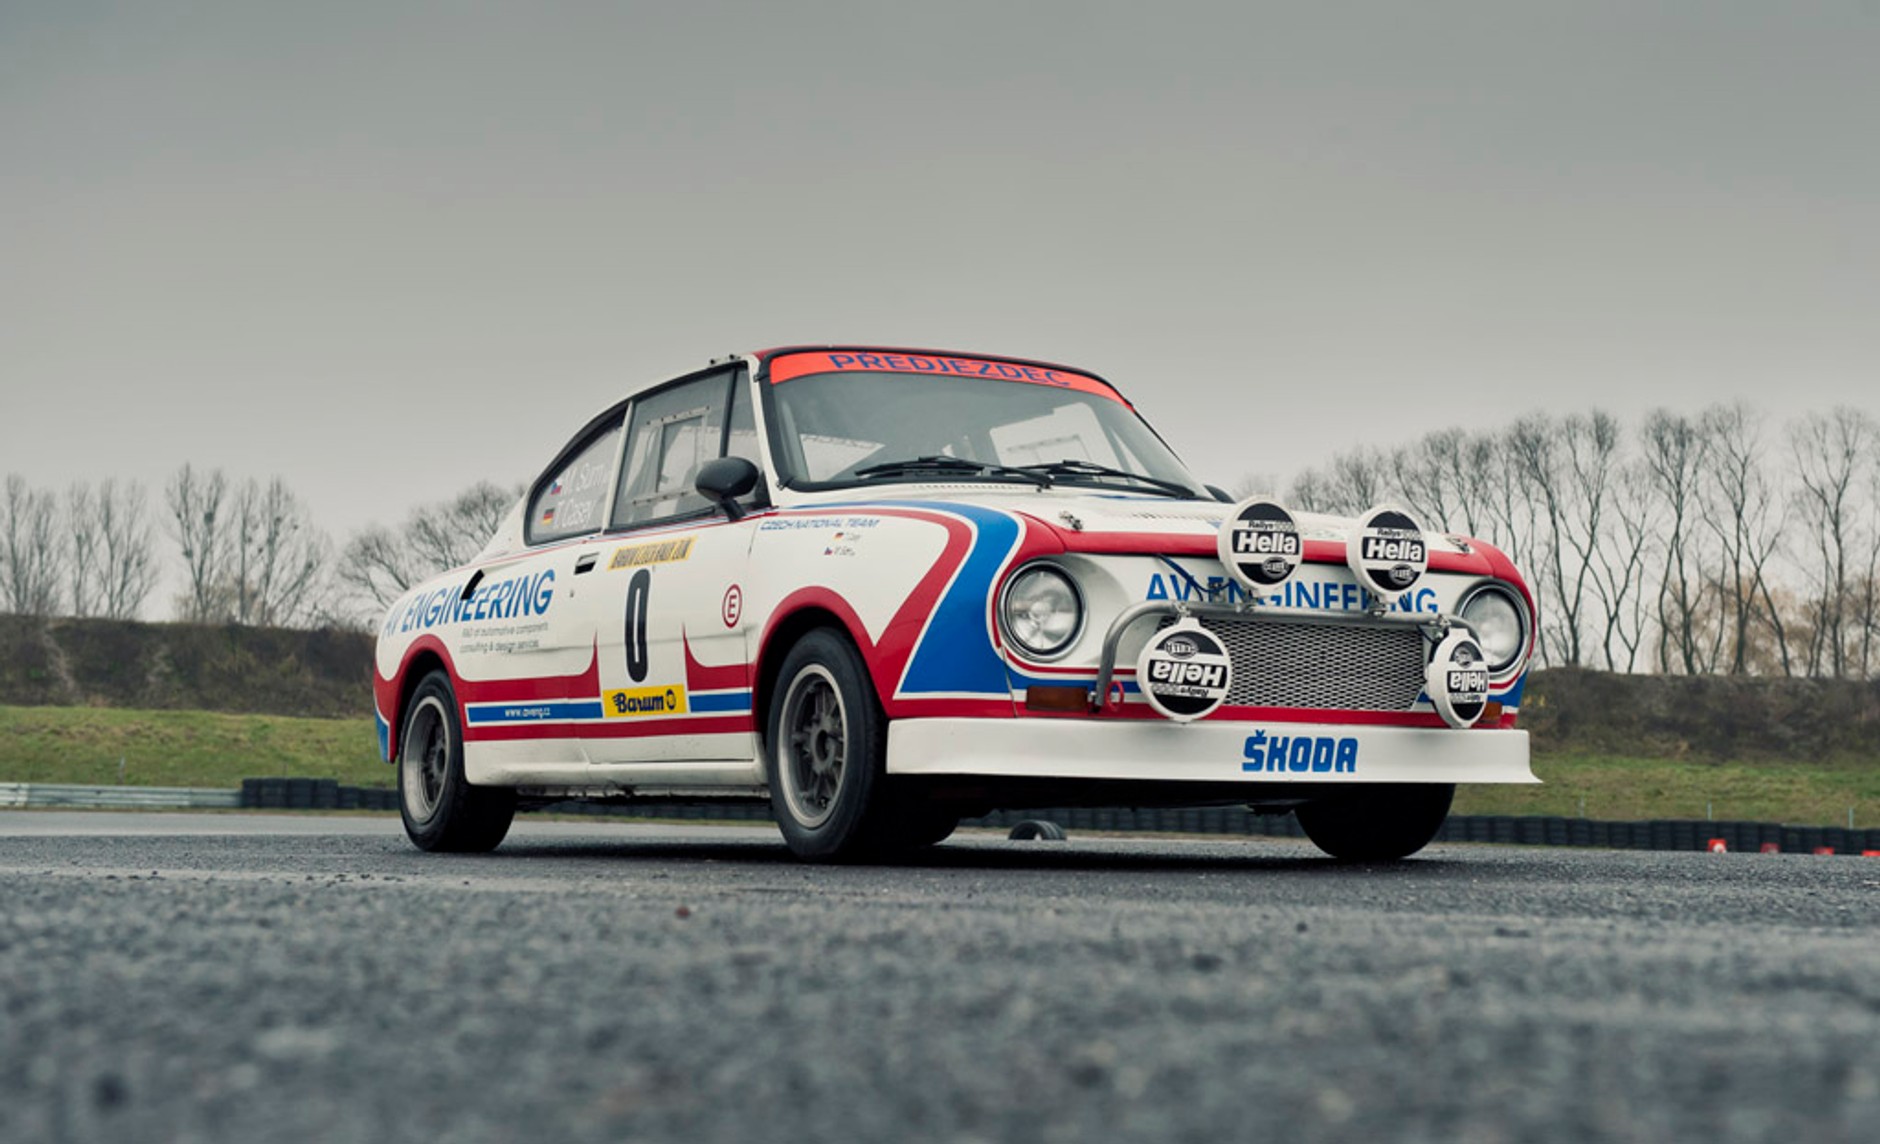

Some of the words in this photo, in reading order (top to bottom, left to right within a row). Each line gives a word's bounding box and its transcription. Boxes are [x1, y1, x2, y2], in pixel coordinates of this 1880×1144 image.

[846, 517, 880, 528] TEAM
[1237, 532, 1297, 553] Hella
[1366, 539, 1422, 561] Hella
[1146, 573, 1194, 602] AV
[401, 568, 555, 633] ENGINEERING
[624, 568, 650, 683] 0
[1152, 661, 1223, 687] Hella
[1450, 671, 1486, 693] Hella
[613, 692, 664, 714] Barum
[1242, 729, 1358, 772] ŠKODA
